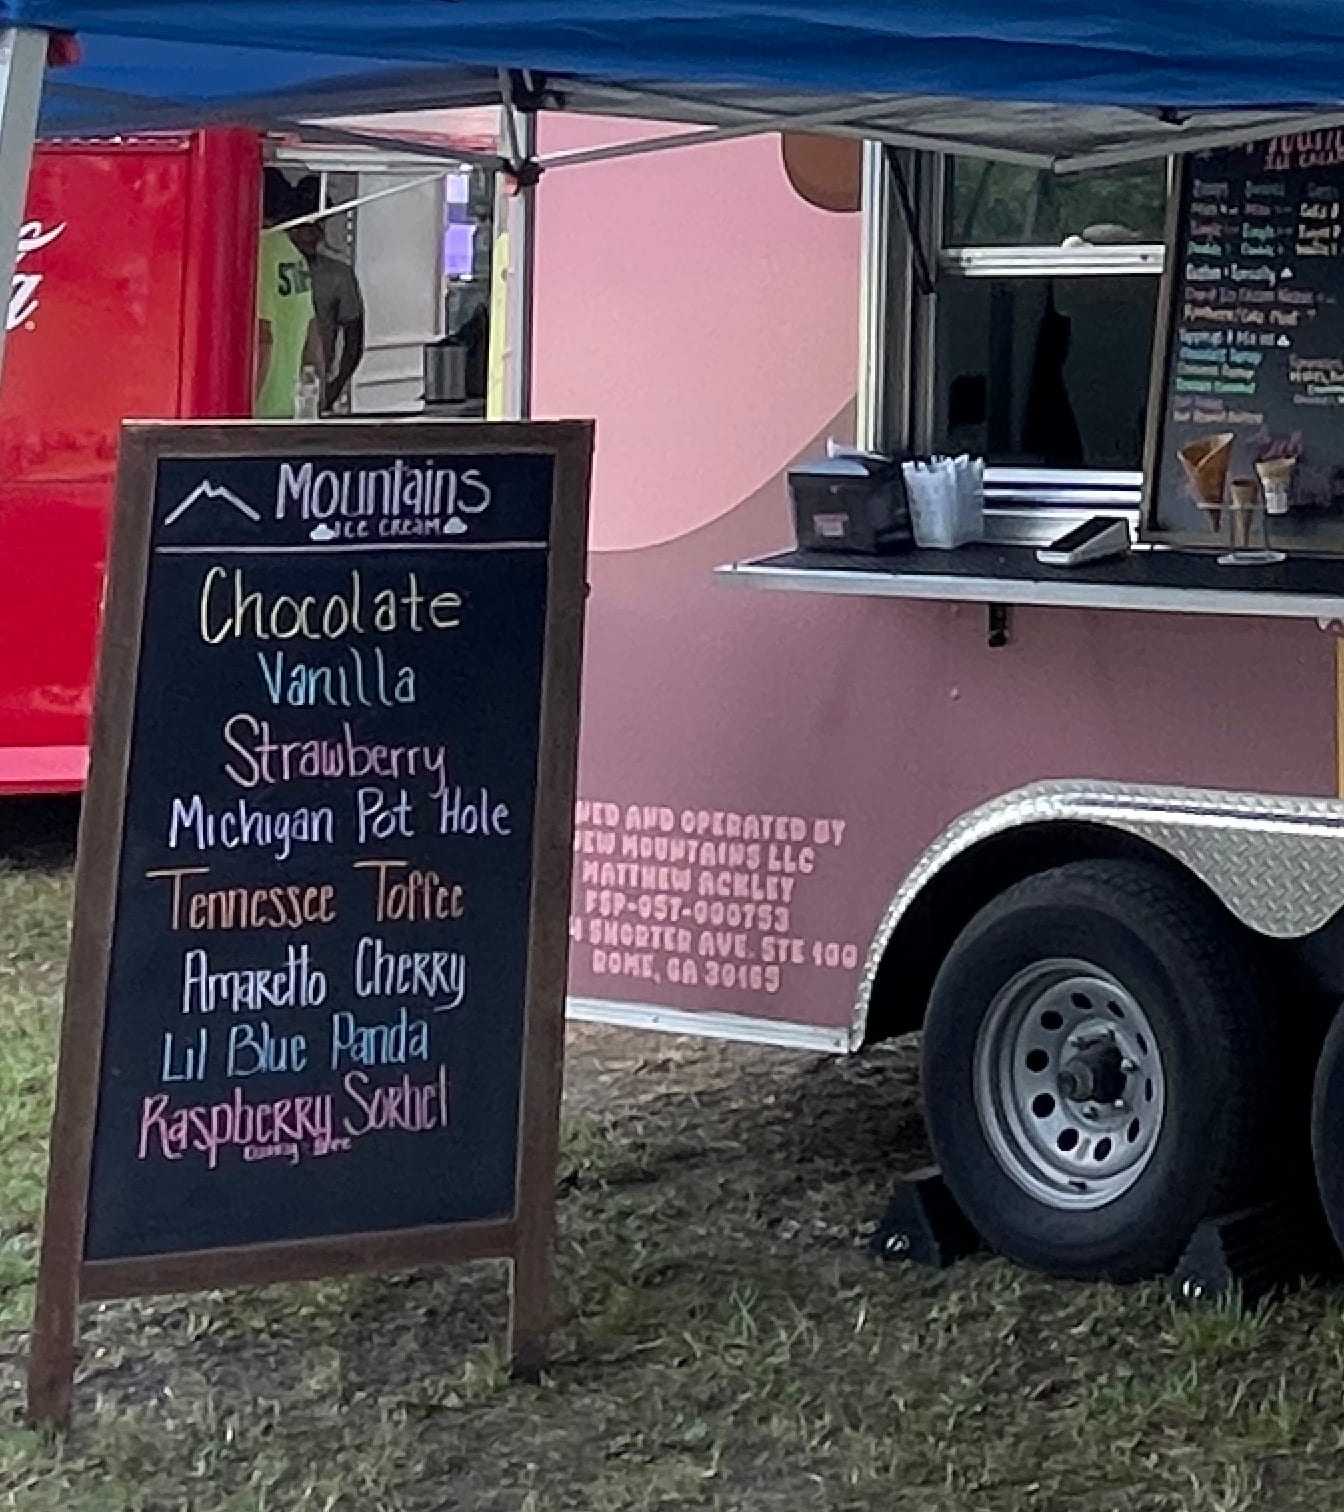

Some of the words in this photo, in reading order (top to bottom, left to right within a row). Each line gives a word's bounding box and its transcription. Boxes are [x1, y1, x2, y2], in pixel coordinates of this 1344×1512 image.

[276, 459, 491, 519] Mountains
[201, 566, 462, 644] Chocolate
[257, 646, 416, 707] Vanilla
[224, 714, 446, 799] Strawberry
[169, 794, 334, 861] Michigan
[357, 787, 414, 844] Pot
[440, 786, 512, 836] Hole
[574, 829, 616, 856] EW
[621, 836, 761, 870] MOUNTAINS
[768, 844, 816, 874] LLC
[624, 804, 675, 832] AND
[680, 809, 806, 842] OPERATED
[145, 866, 337, 930] Tennessee
[352, 861, 464, 922] Toffee
[582, 860, 692, 892] MATTHEW
[589, 918, 692, 953] SHORTER
[761, 935, 806, 964] STE
[813, 941, 858, 969] 100
[667, 956, 698, 985] GA
[162, 1028, 207, 1081] Lil
[227, 1021, 307, 1080] Blue
[331, 1007, 430, 1071] Panda
[138, 1087, 334, 1170] Raspberry
